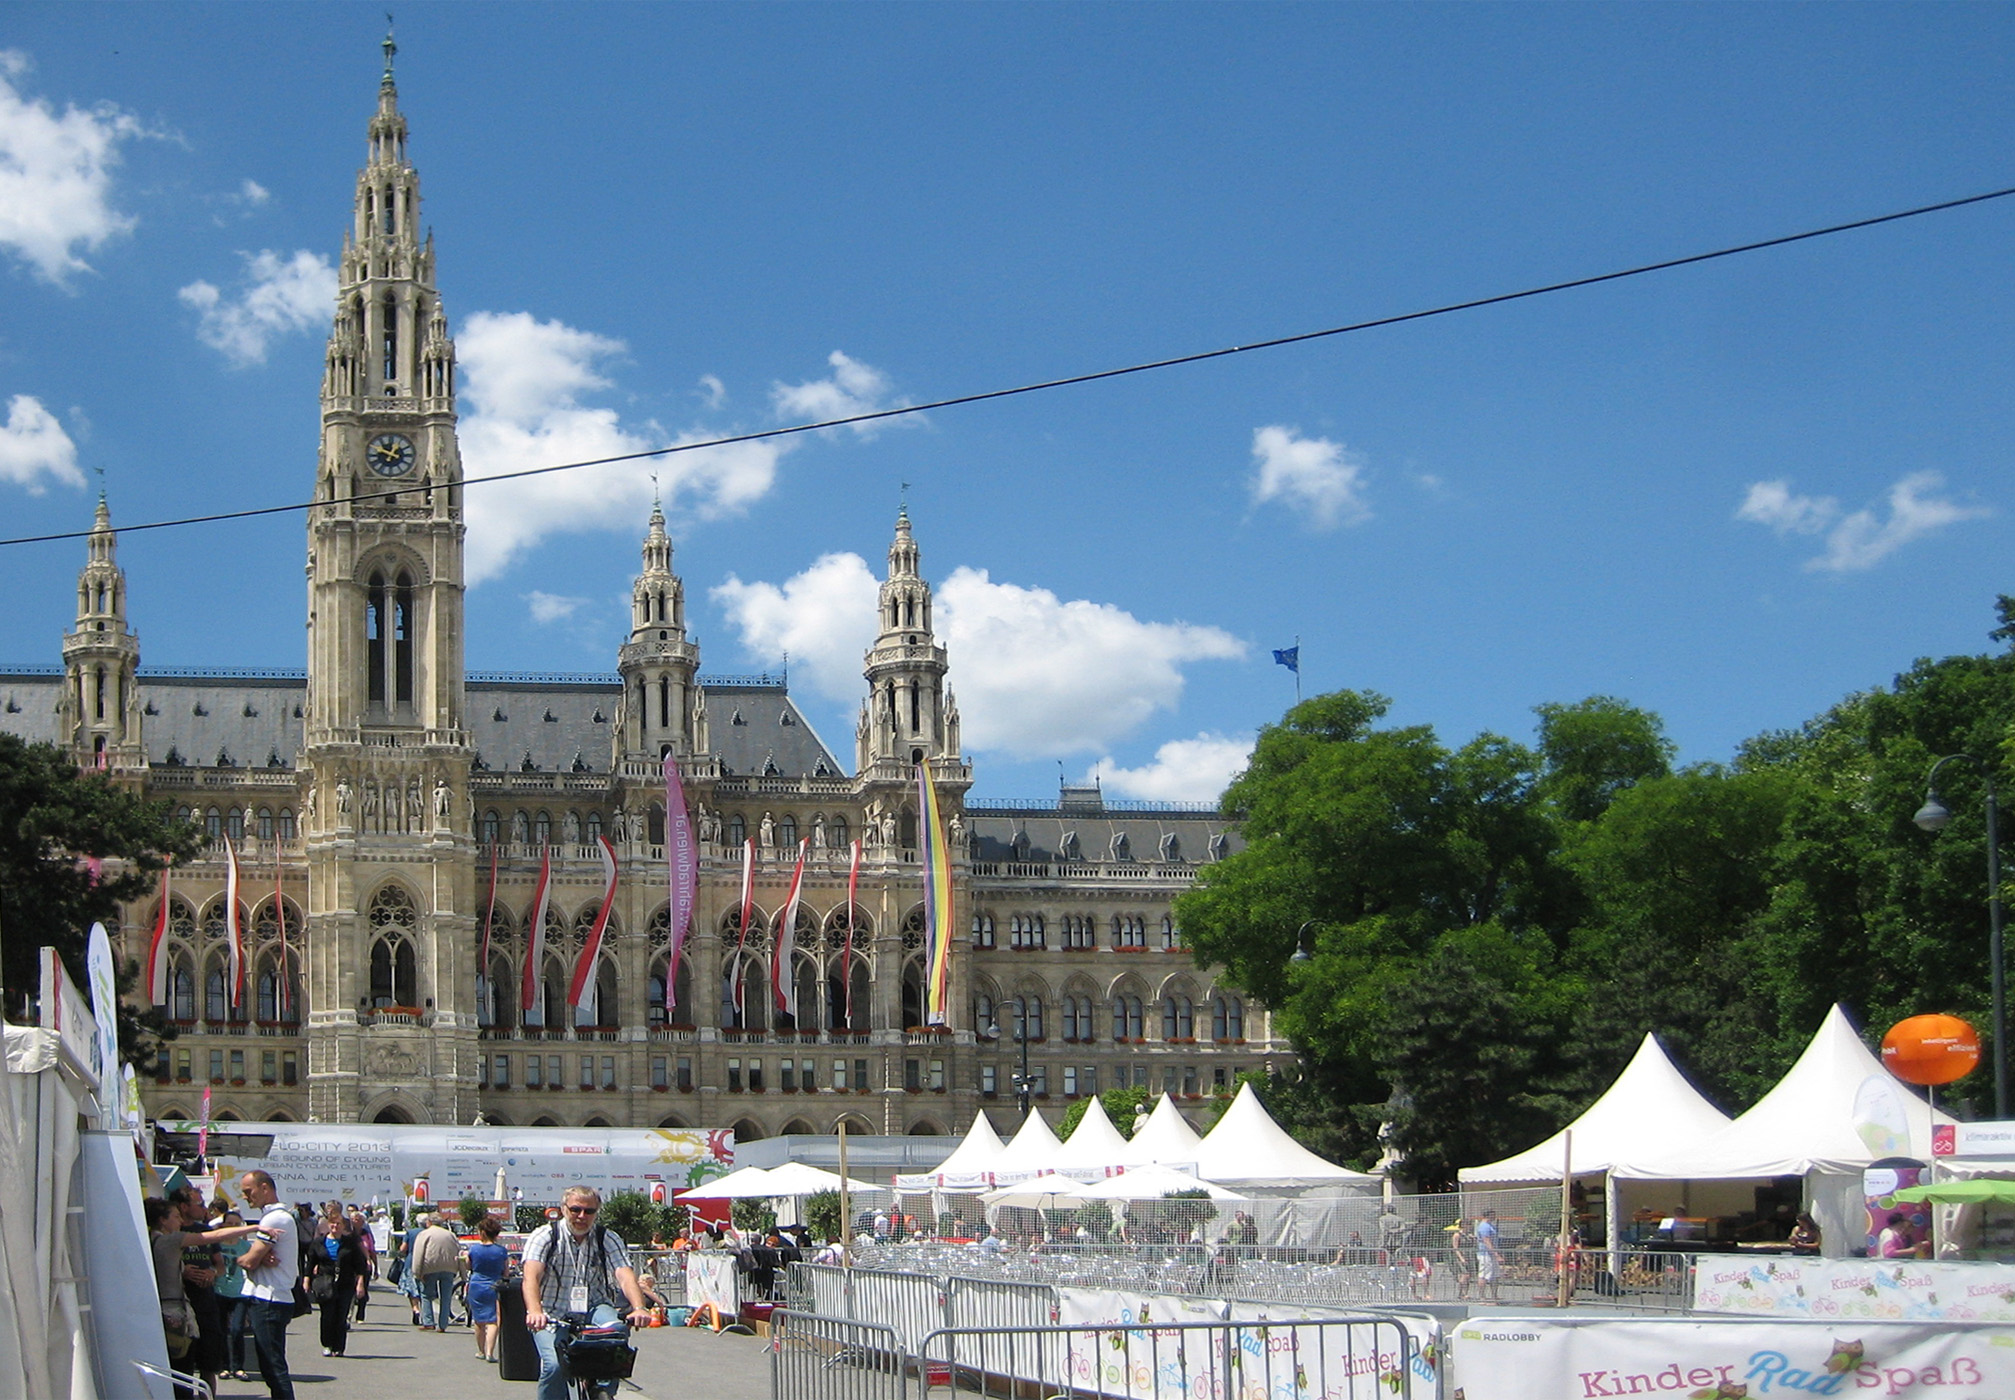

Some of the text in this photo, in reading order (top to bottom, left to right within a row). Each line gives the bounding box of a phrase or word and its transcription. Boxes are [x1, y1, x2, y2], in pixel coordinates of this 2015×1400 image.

[348, 1143, 391, 1152] 2013
[1713, 1270, 1749, 1284] Kinder
[1772, 1268, 1801, 1283] Spaß
[1831, 1275, 1871, 1290] Kinder
[1900, 1274, 1933, 1289] Spaß
[1966, 1281, 2012, 1297] Kinder
[1483, 1333, 1541, 1341] RADLOBBY
[1578, 1350, 1982, 1398] Kinder Rad Spaß
